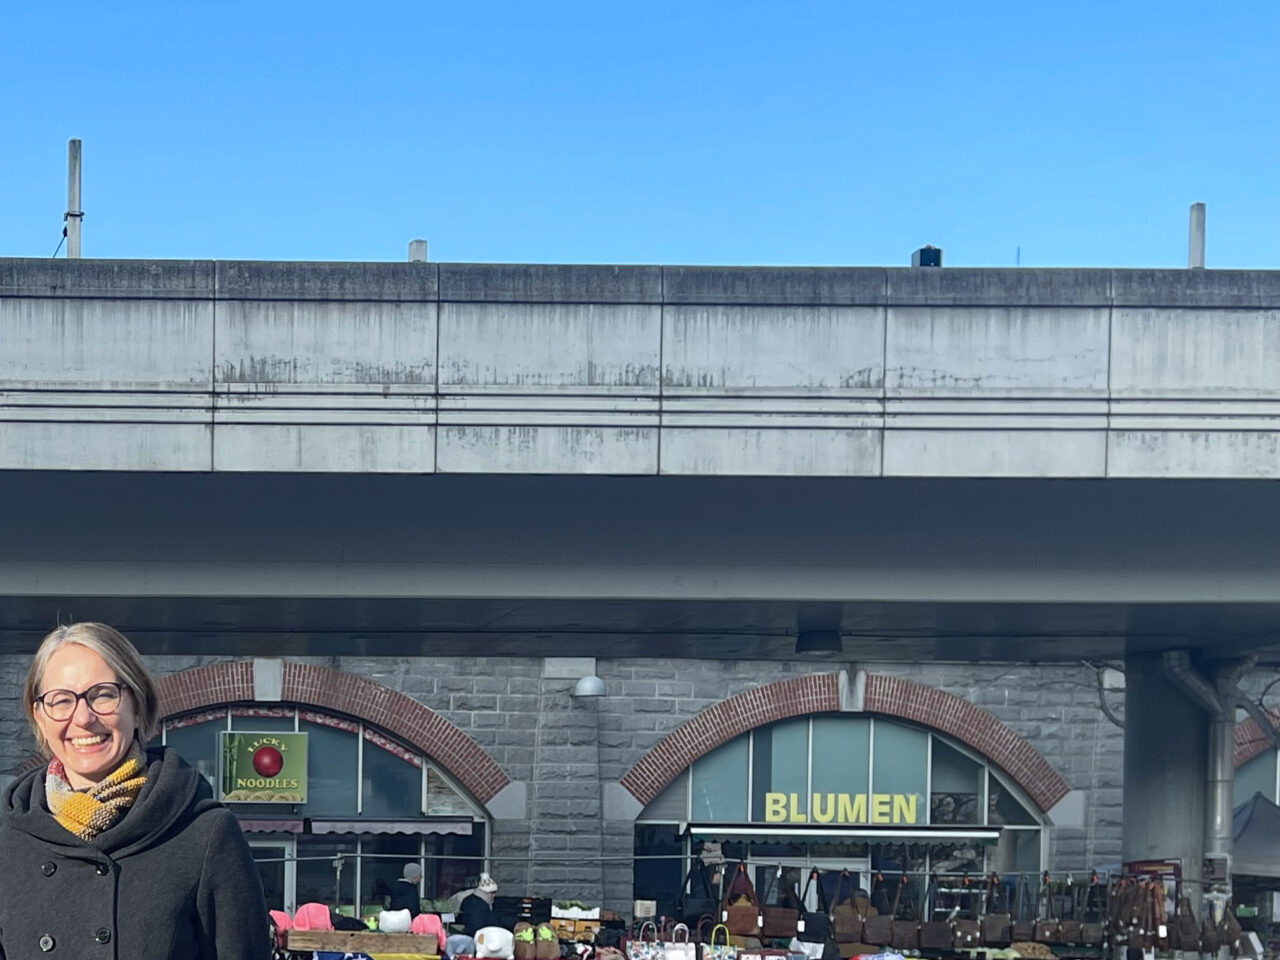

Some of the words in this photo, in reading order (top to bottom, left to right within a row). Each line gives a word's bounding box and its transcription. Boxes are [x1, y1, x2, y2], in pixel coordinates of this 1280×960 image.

[247, 737, 288, 753] LUCKY
[237, 778, 298, 789] NOODLES
[765, 792, 917, 824] BLUMEN
